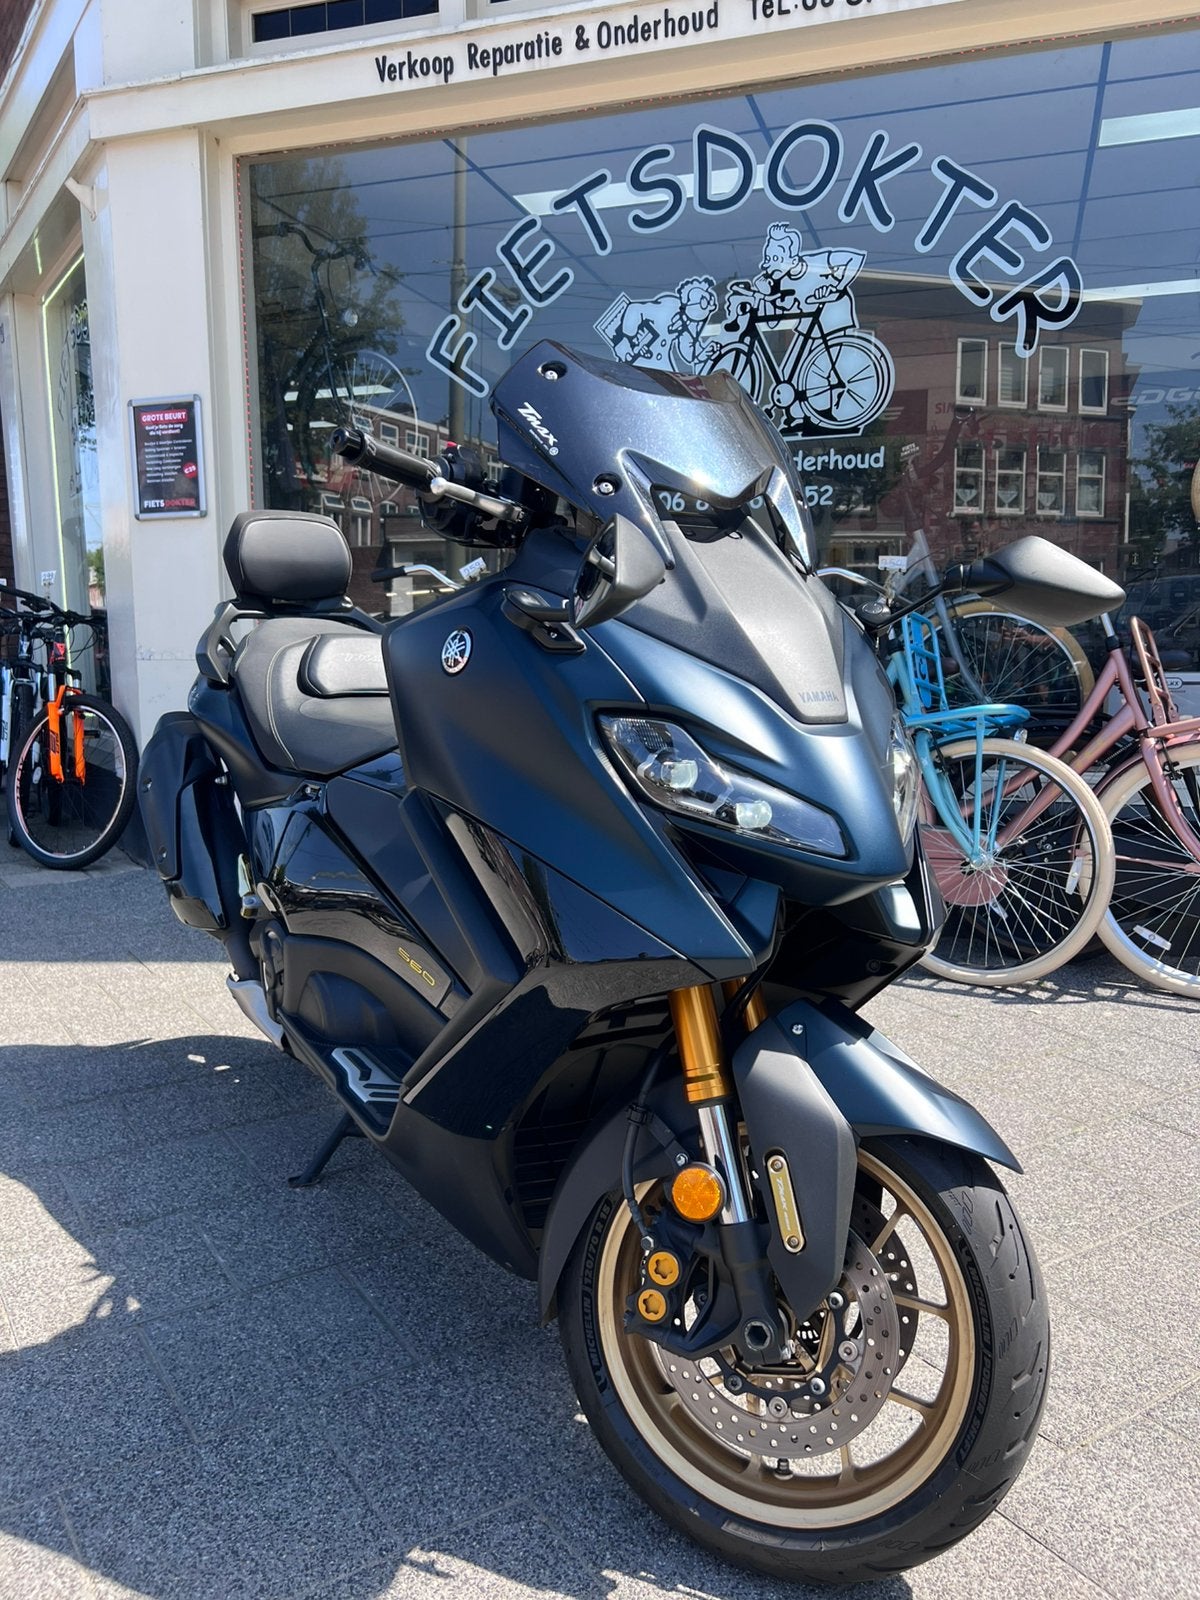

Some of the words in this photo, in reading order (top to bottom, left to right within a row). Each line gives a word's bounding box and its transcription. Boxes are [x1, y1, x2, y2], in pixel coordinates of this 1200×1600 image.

[374, 51, 454, 84] Verkoop
[467, 31, 563, 77] Reparatie
[575, 24, 590, 51] &
[597, 1, 719, 49] Onderhoud
[141, 413, 164, 422] GROTE
[164, 411, 187, 421] BEURT
[804, 484, 834, 507] 52
[799, 690, 840, 703] YAMAHA
[583, 1296, 601, 1367] MICHELIN
